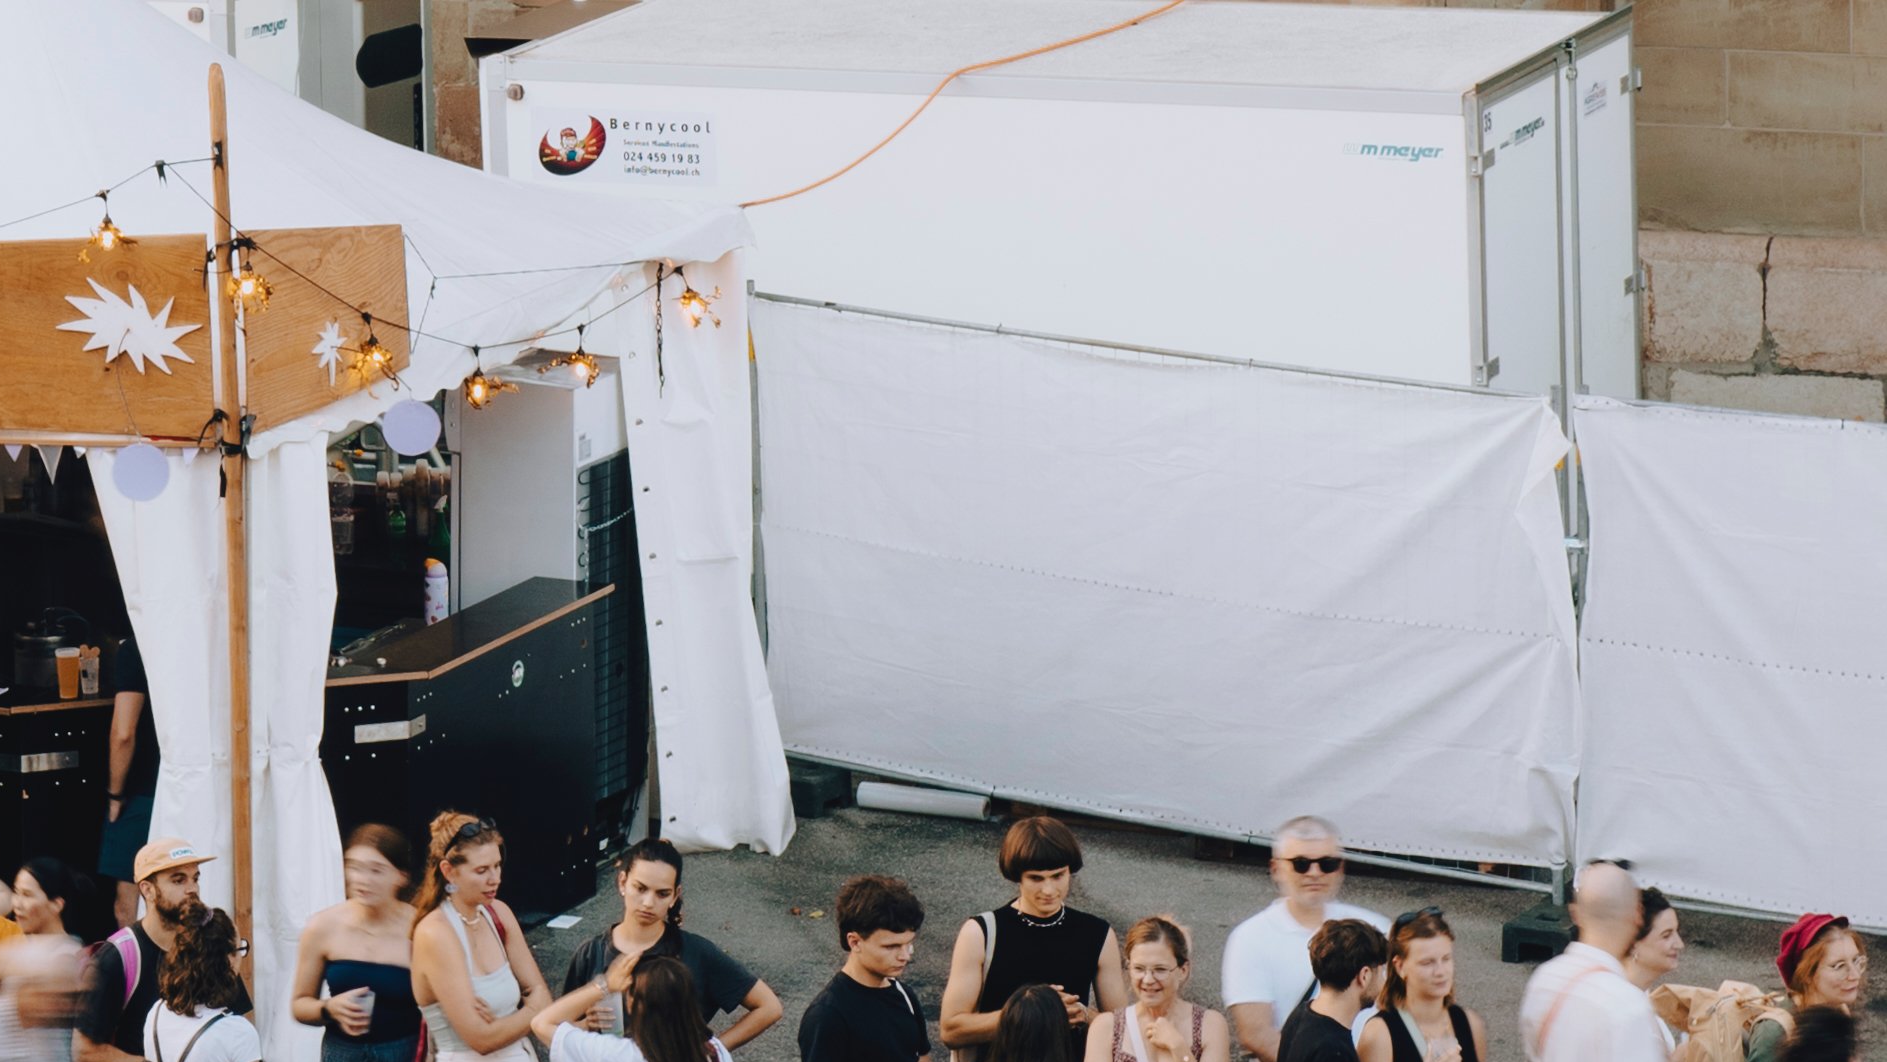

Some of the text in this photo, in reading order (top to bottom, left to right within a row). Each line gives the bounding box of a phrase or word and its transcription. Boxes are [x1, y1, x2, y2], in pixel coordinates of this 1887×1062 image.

[610, 118, 711, 134] Bernycool
[623, 151, 700, 164] 024 459 19 83
[1380, 145, 1444, 162] meyer
[623, 165, 700, 177] info@bernycool.ch
